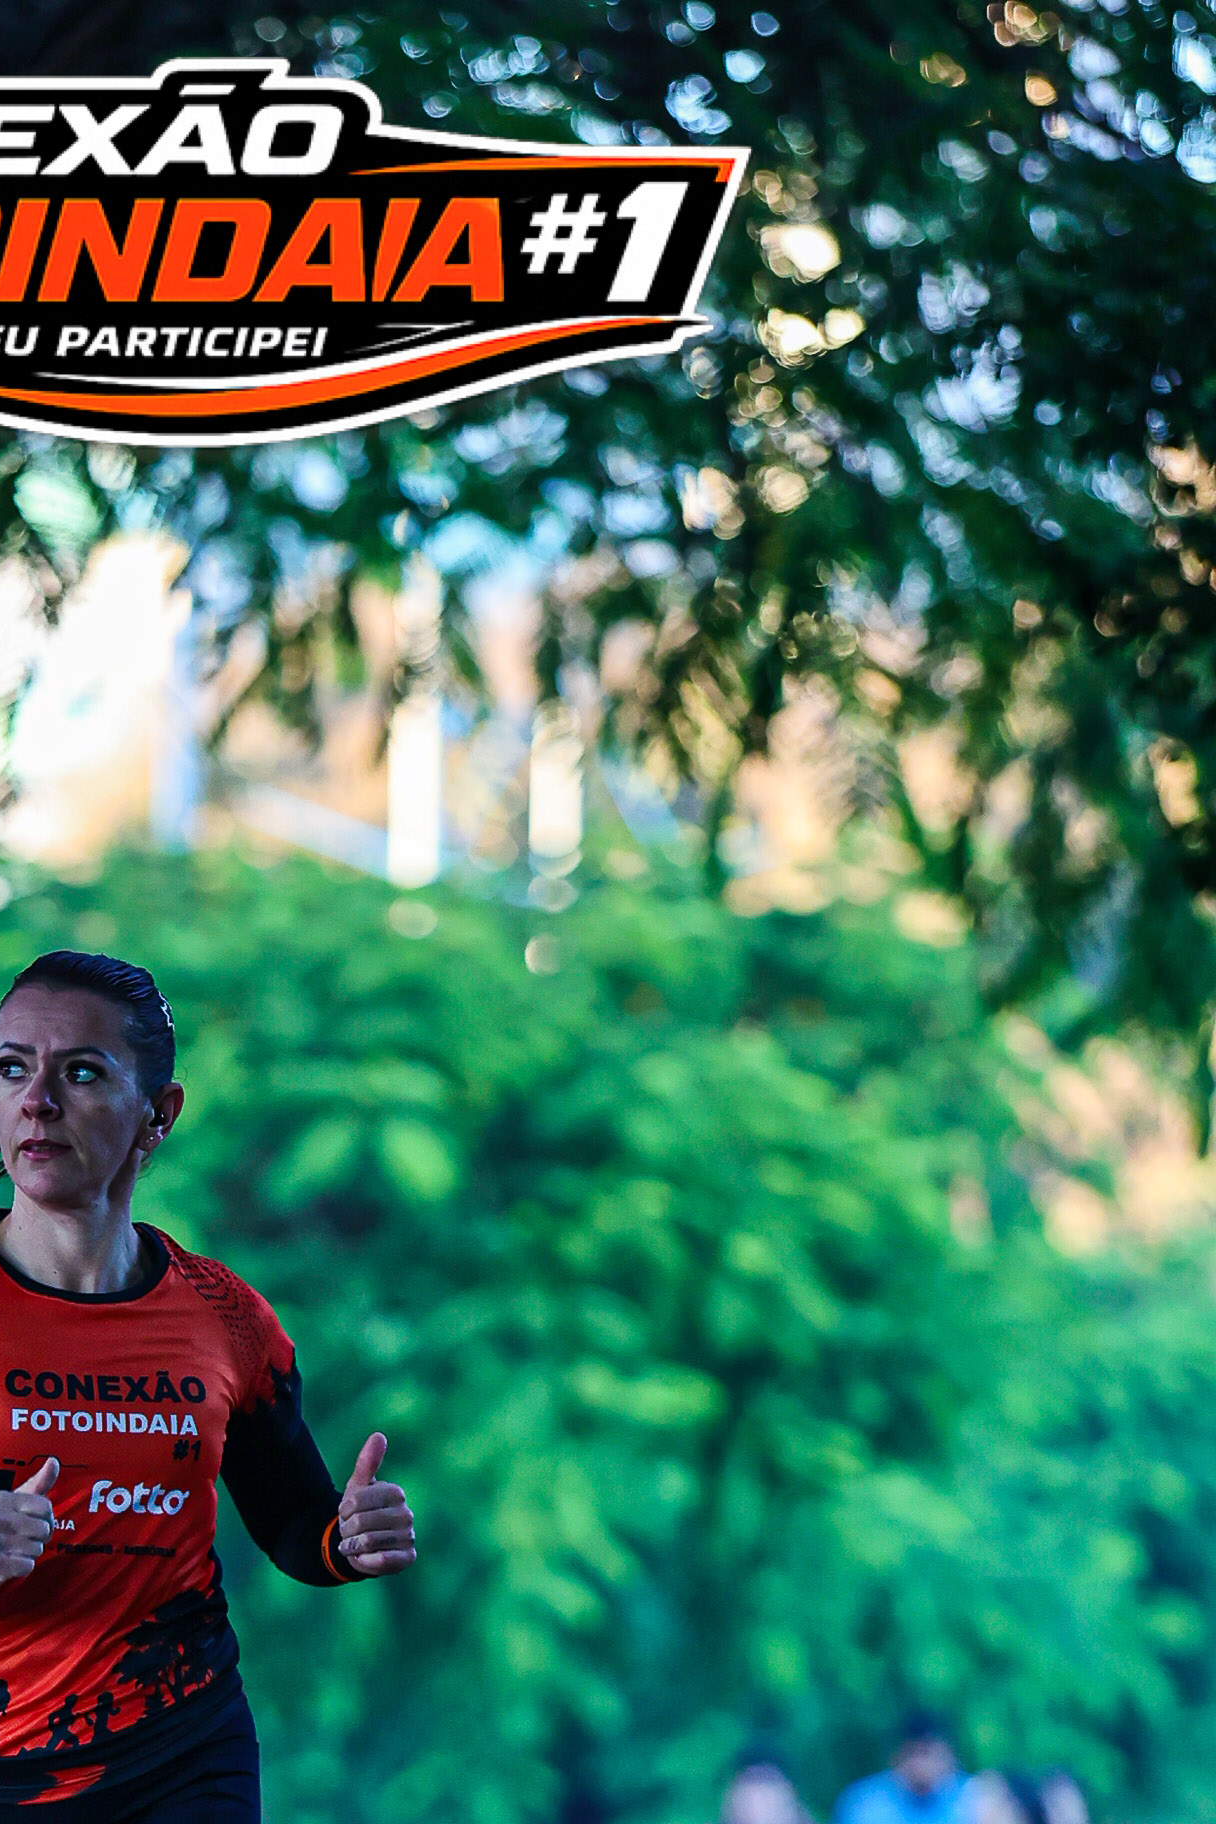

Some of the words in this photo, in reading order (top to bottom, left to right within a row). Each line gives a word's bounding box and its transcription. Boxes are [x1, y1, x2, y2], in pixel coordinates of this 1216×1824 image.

[5, 1368, 206, 1403] CONEXÃO
[11, 1408, 198, 1436] FOTOINDAIA
[172, 1439, 202, 1462] #1
[88, 1479, 190, 1515] fotto
